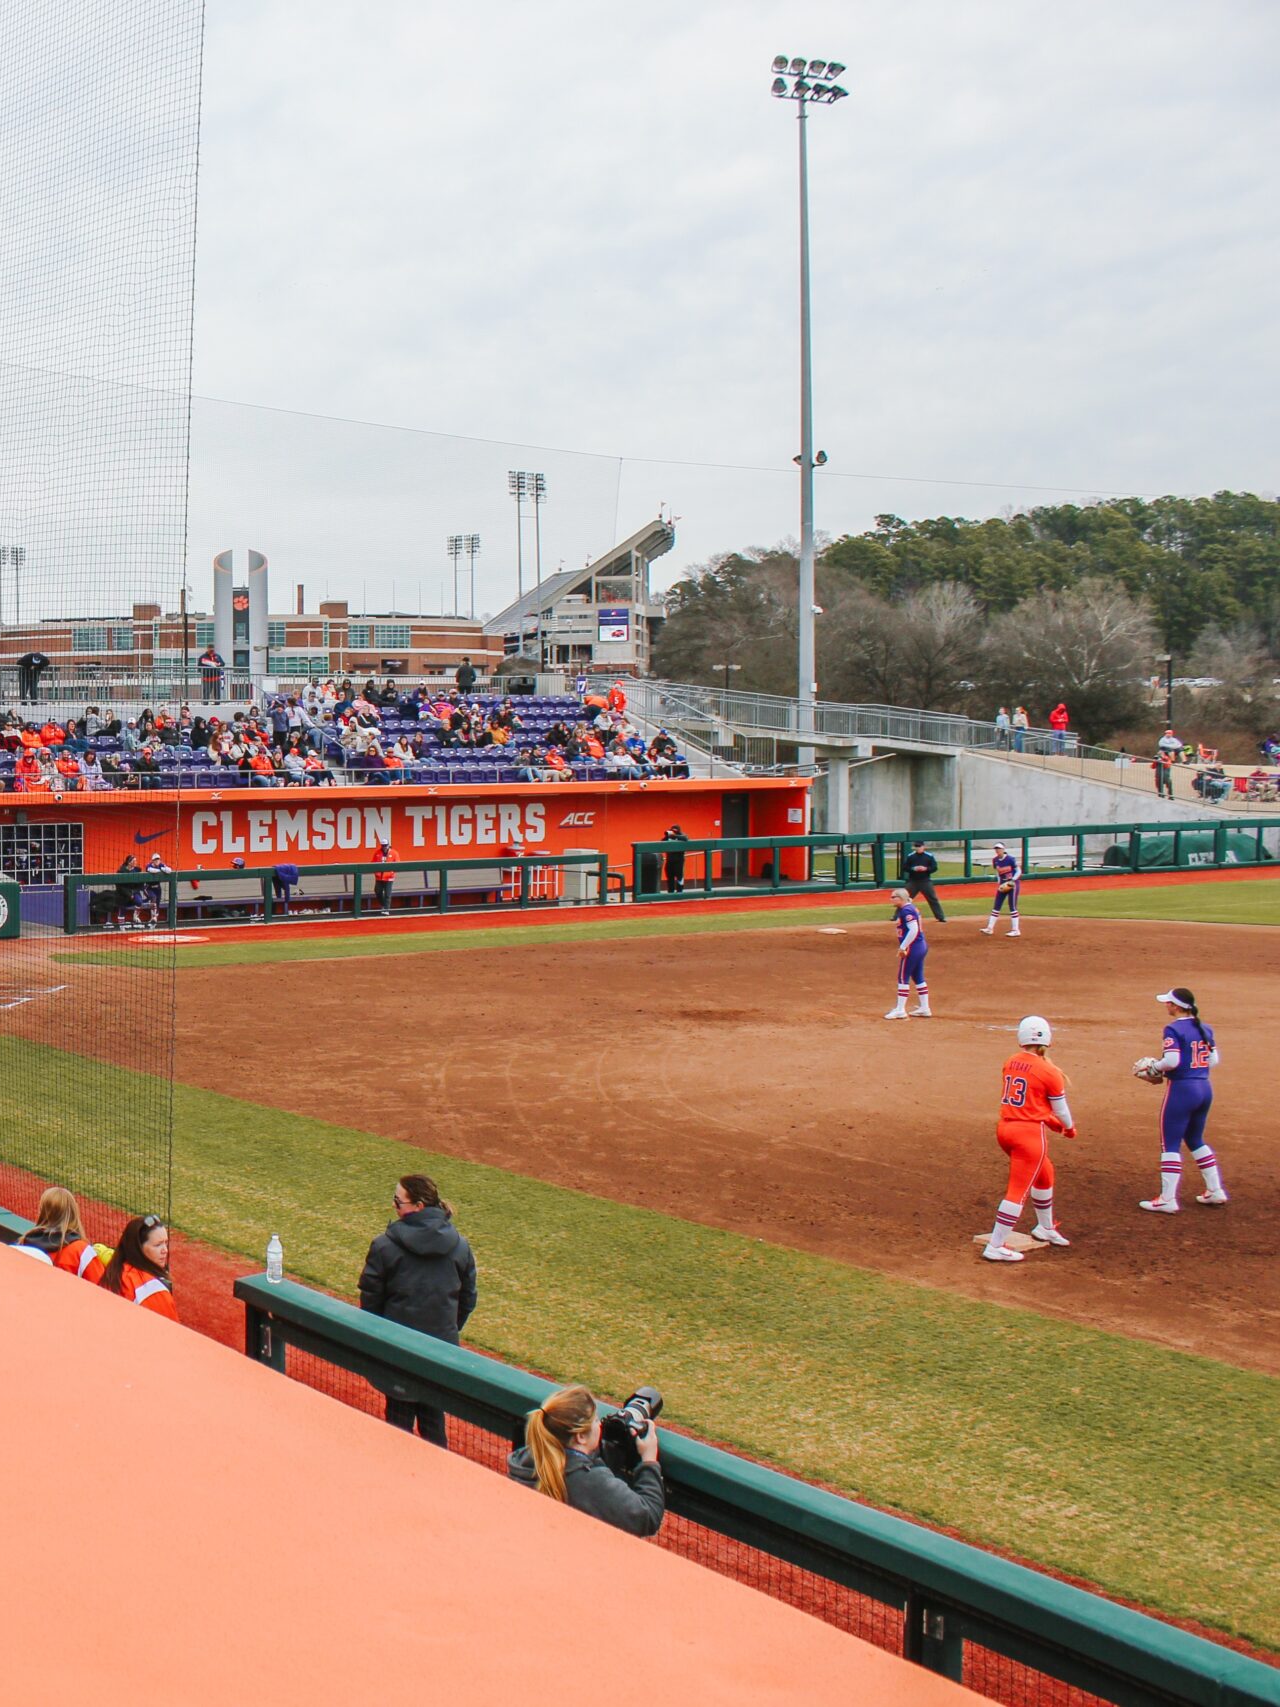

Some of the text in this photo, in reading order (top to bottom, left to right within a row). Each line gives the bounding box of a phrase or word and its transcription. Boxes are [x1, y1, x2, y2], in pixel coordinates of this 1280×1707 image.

[192, 803, 546, 854] CLEMSON TIGERS
[559, 812, 597, 825] ACC
[1190, 1040, 1210, 1068] 12
[1001, 1074, 1027, 1107] 13
